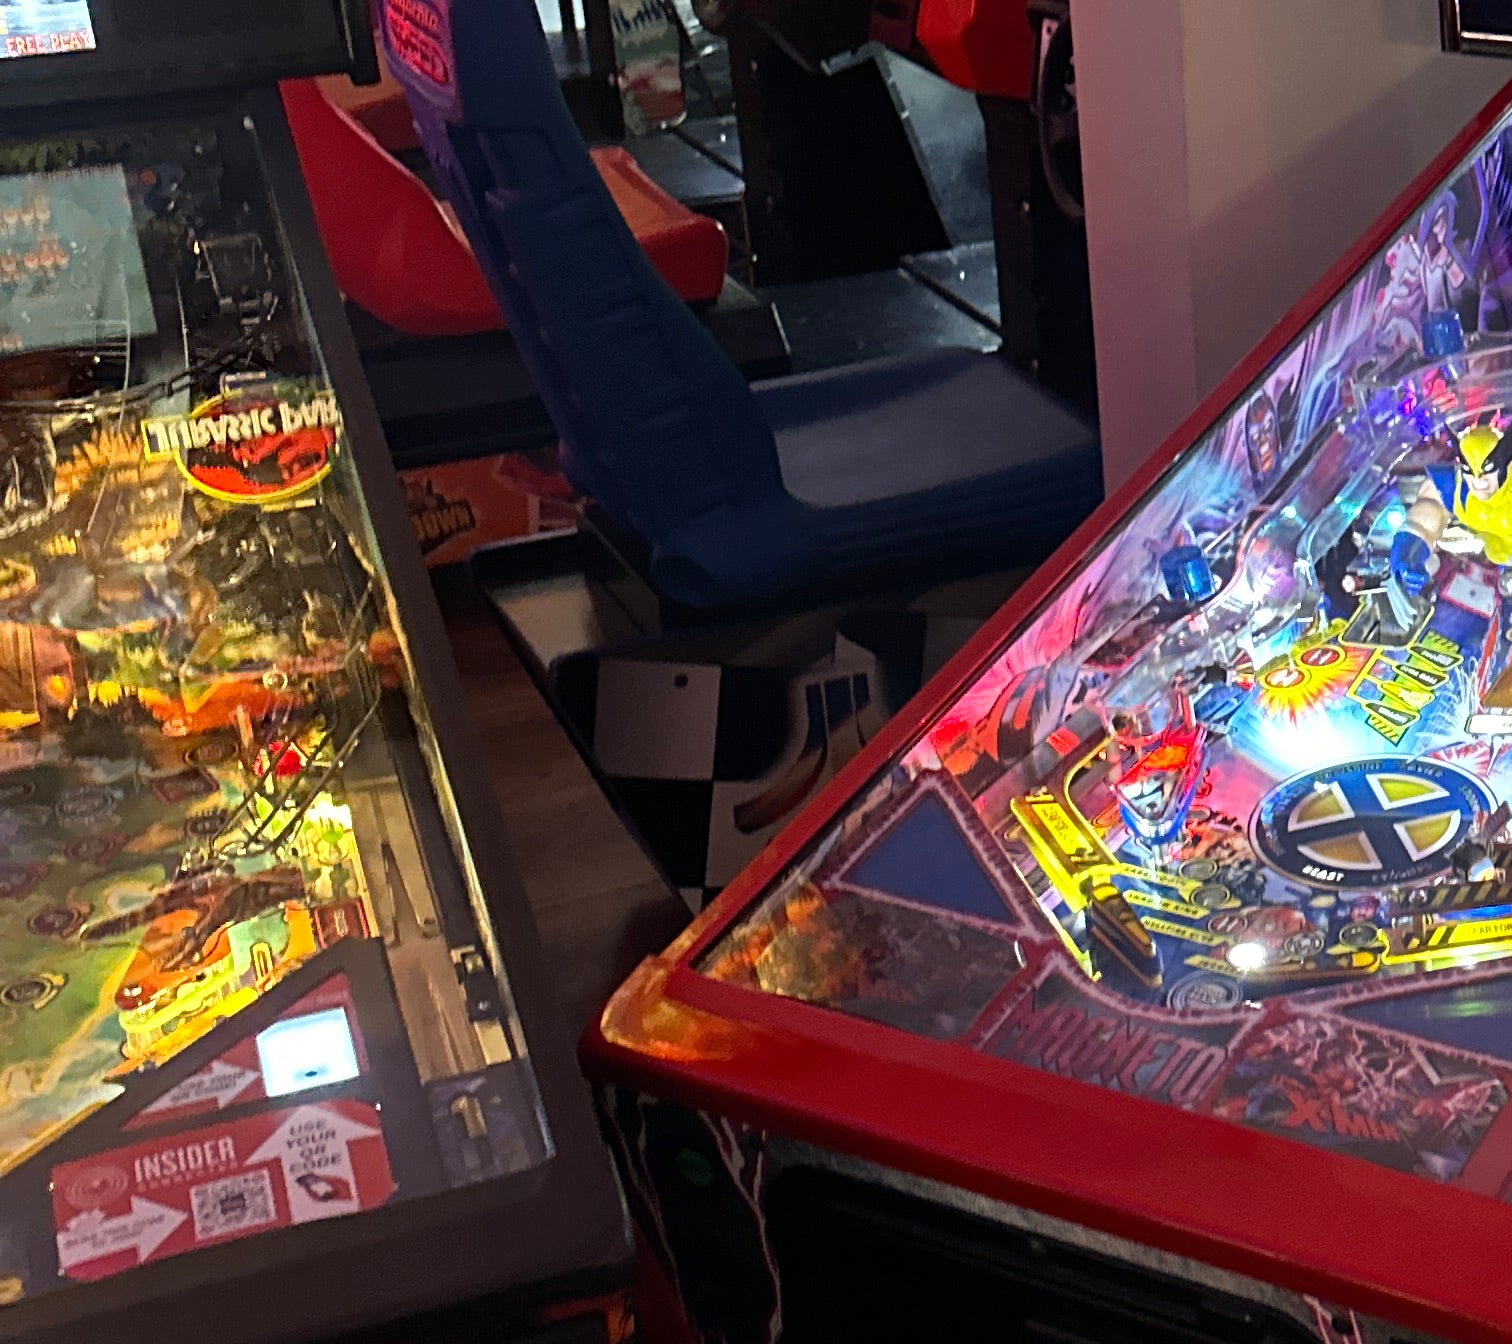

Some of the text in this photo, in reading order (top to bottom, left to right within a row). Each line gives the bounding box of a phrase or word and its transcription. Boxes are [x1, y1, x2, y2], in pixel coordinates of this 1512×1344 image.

[1302, 864, 1345, 883] BEAST
[1008, 998, 1234, 1112] MAGNETO
[134, 1136, 237, 1182] INSIDER
